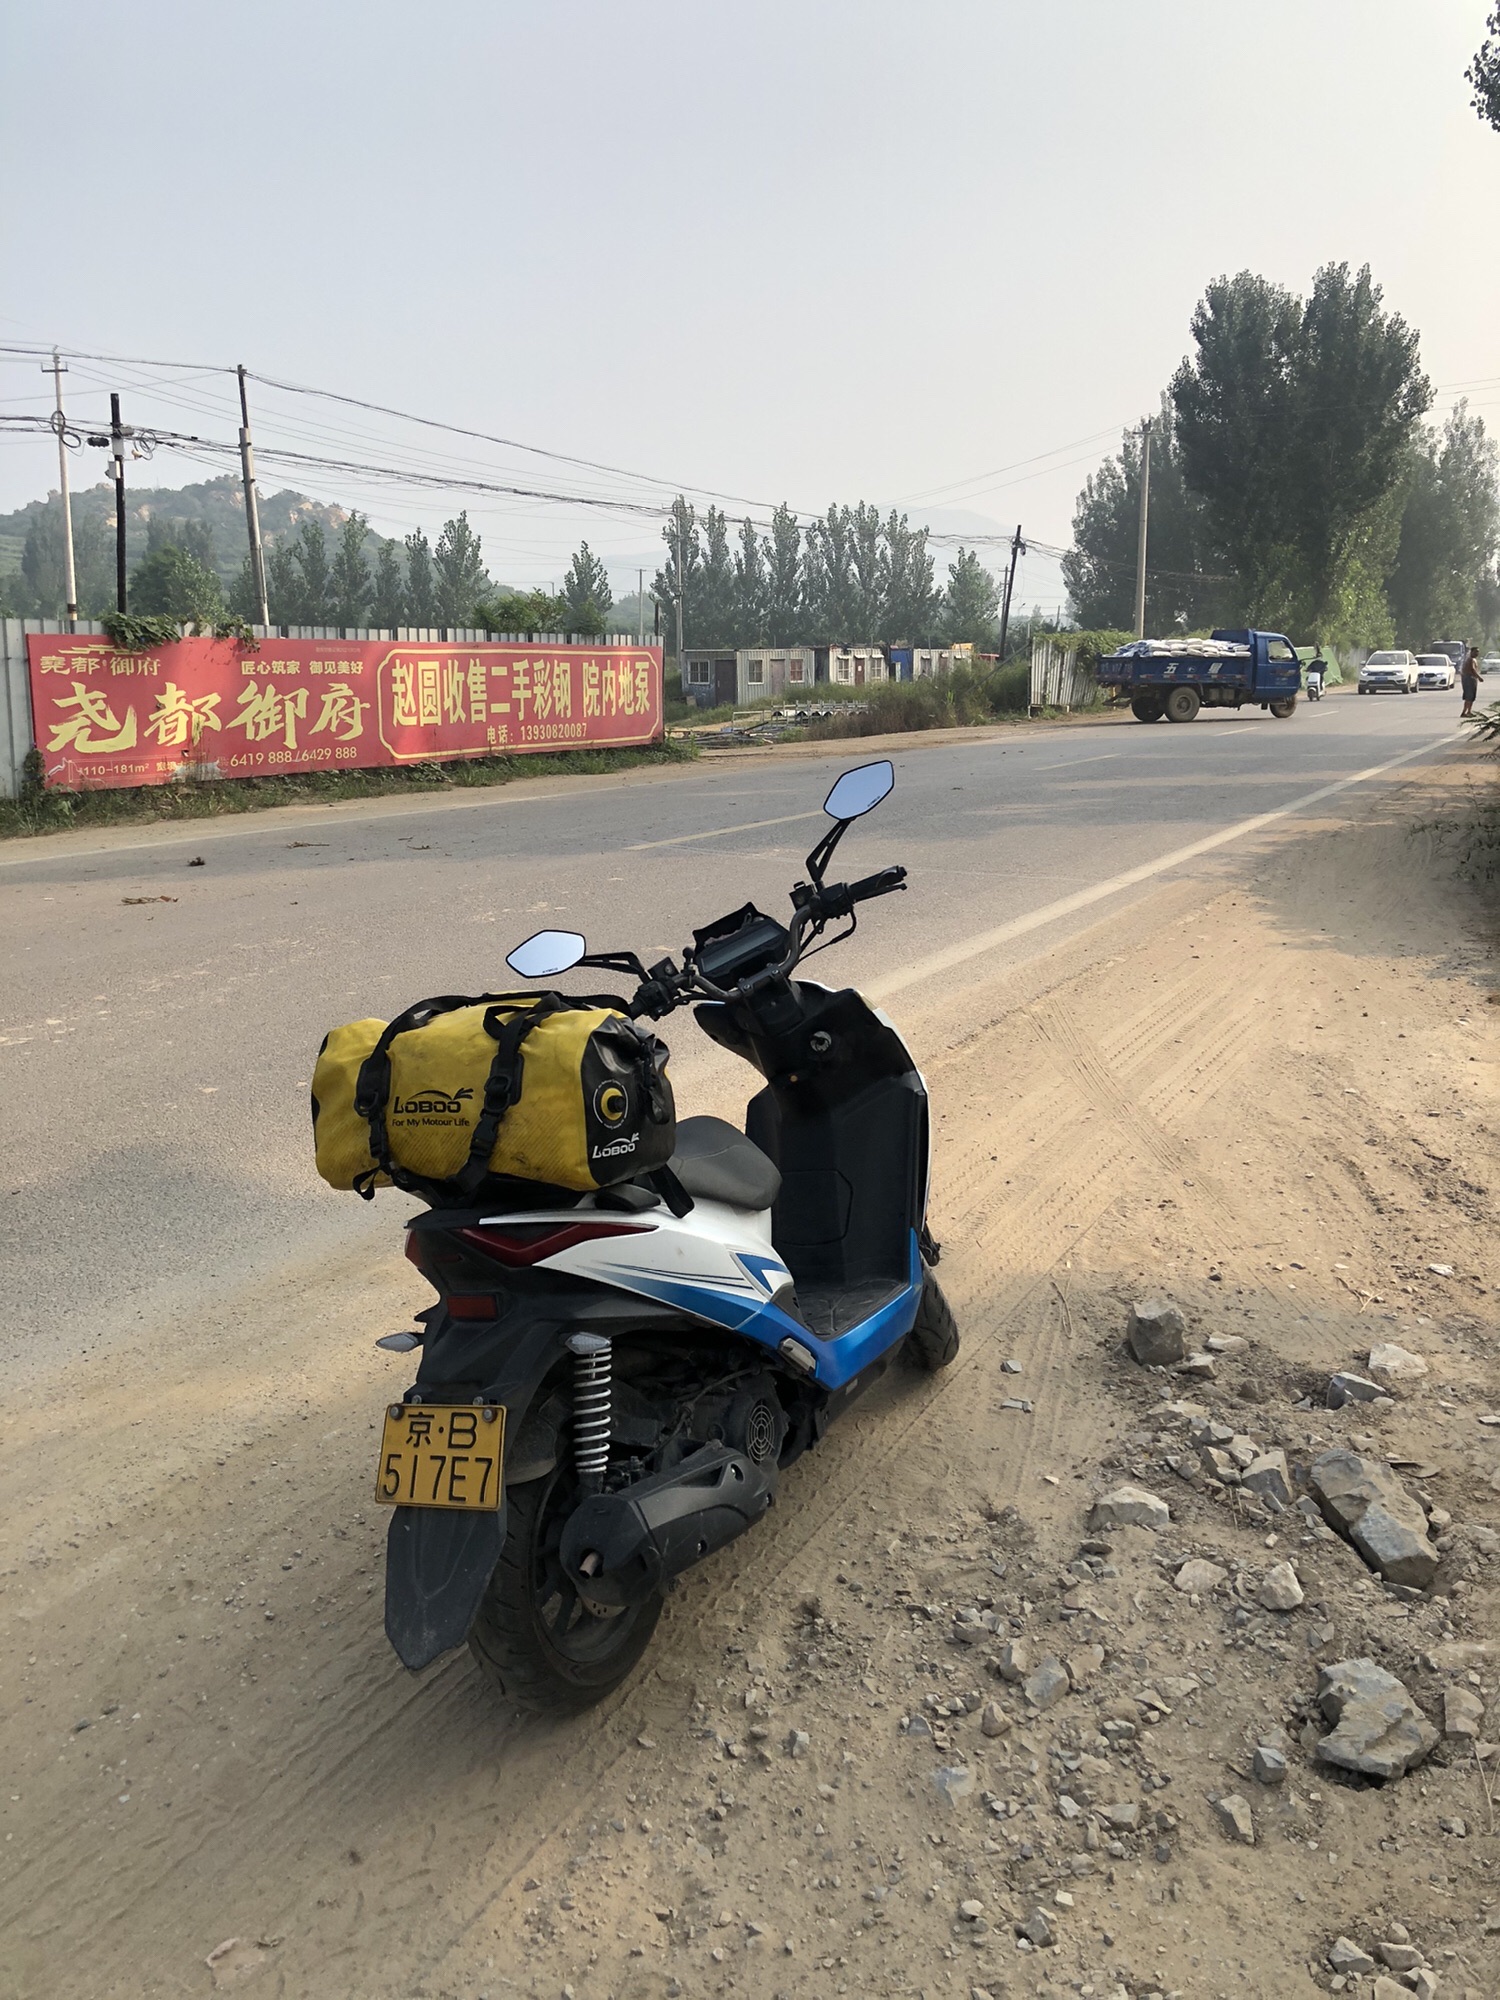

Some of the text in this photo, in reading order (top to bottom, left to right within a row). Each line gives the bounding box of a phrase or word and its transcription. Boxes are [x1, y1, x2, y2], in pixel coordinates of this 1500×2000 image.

[241, 660, 363, 675] 匠心筑家 御见美好
[391, 658, 650, 727] 赵圆收售二手彩钢 院内地泵
[46, 680, 371, 753] 尧都御府
[230, 752, 264, 767] 6419
[335, 746, 357, 759] 888
[393, 1096, 462, 1114] LOBOO
[392, 1117, 470, 1128] For My Motour Life
[592, 1143, 636, 1159] LOBOO
[383, 1453, 493, 1504] 517E7
